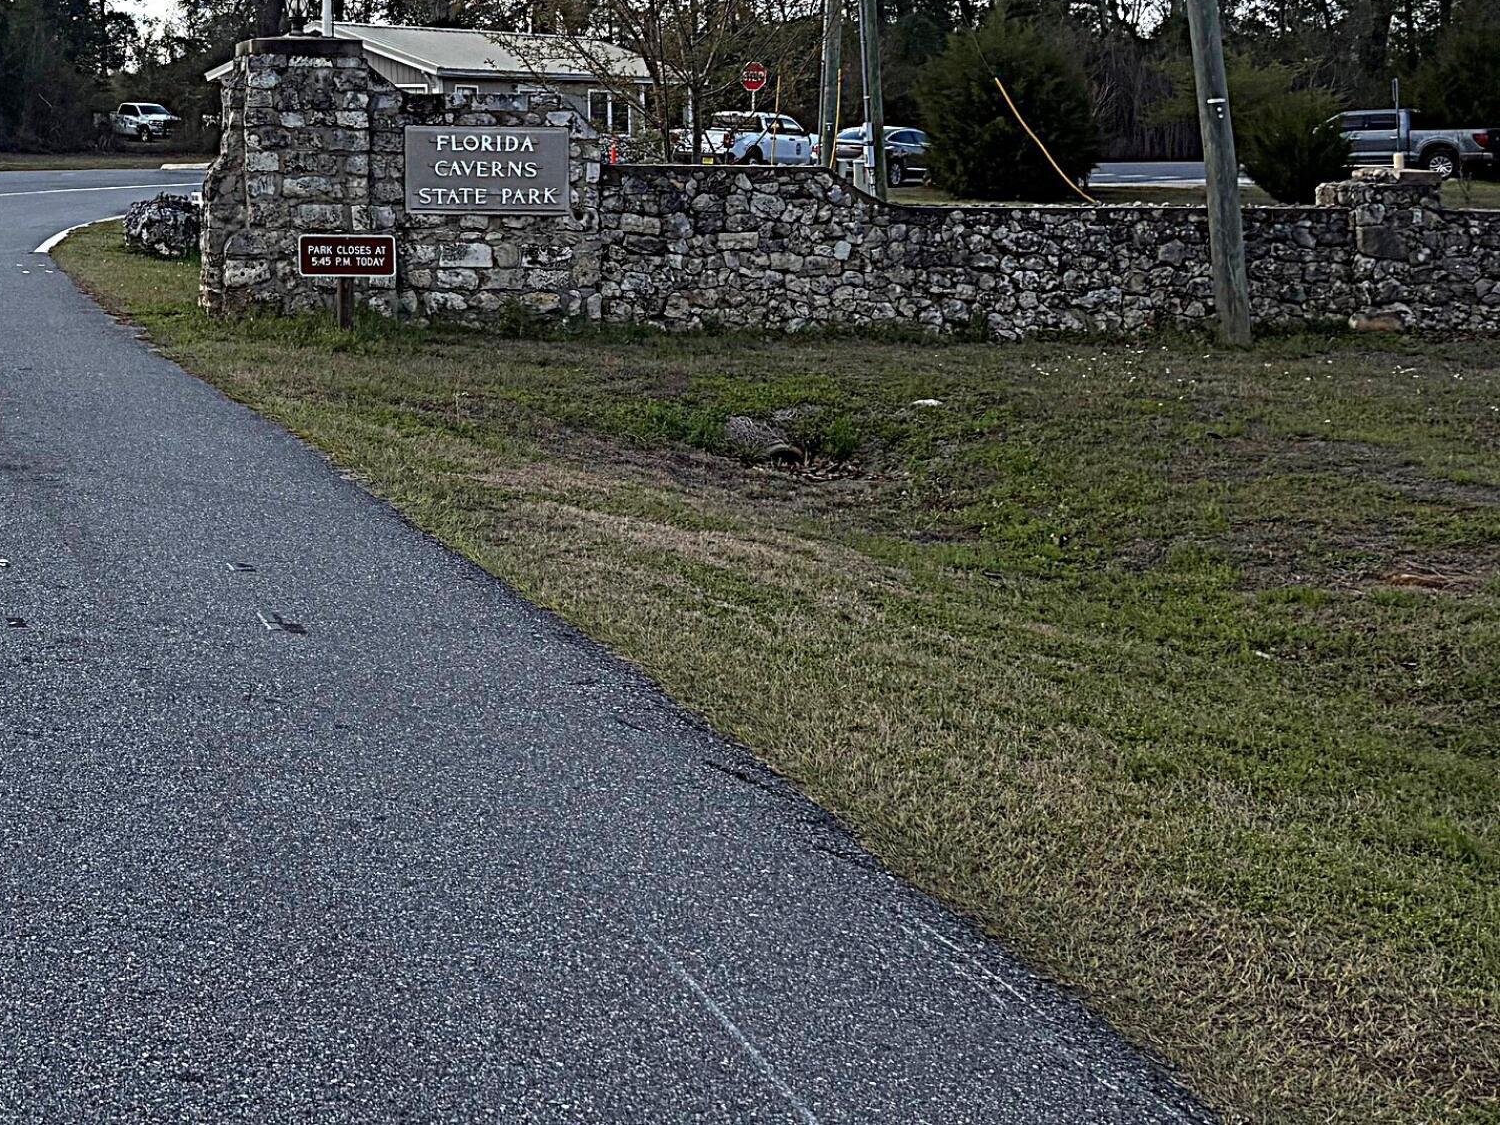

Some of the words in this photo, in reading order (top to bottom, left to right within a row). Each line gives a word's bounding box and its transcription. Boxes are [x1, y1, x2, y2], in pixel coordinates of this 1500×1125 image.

[436, 135, 535, 152] FLORIDA
[434, 160, 538, 178] CAVERNS
[418, 187, 488, 205] STATE
[501, 187, 558, 205] PARK
[307, 245, 333, 255] PARK
[336, 245, 372, 255] CLOSES
[374, 246, 387, 255] AT
[356, 257, 386, 267] TODAY
